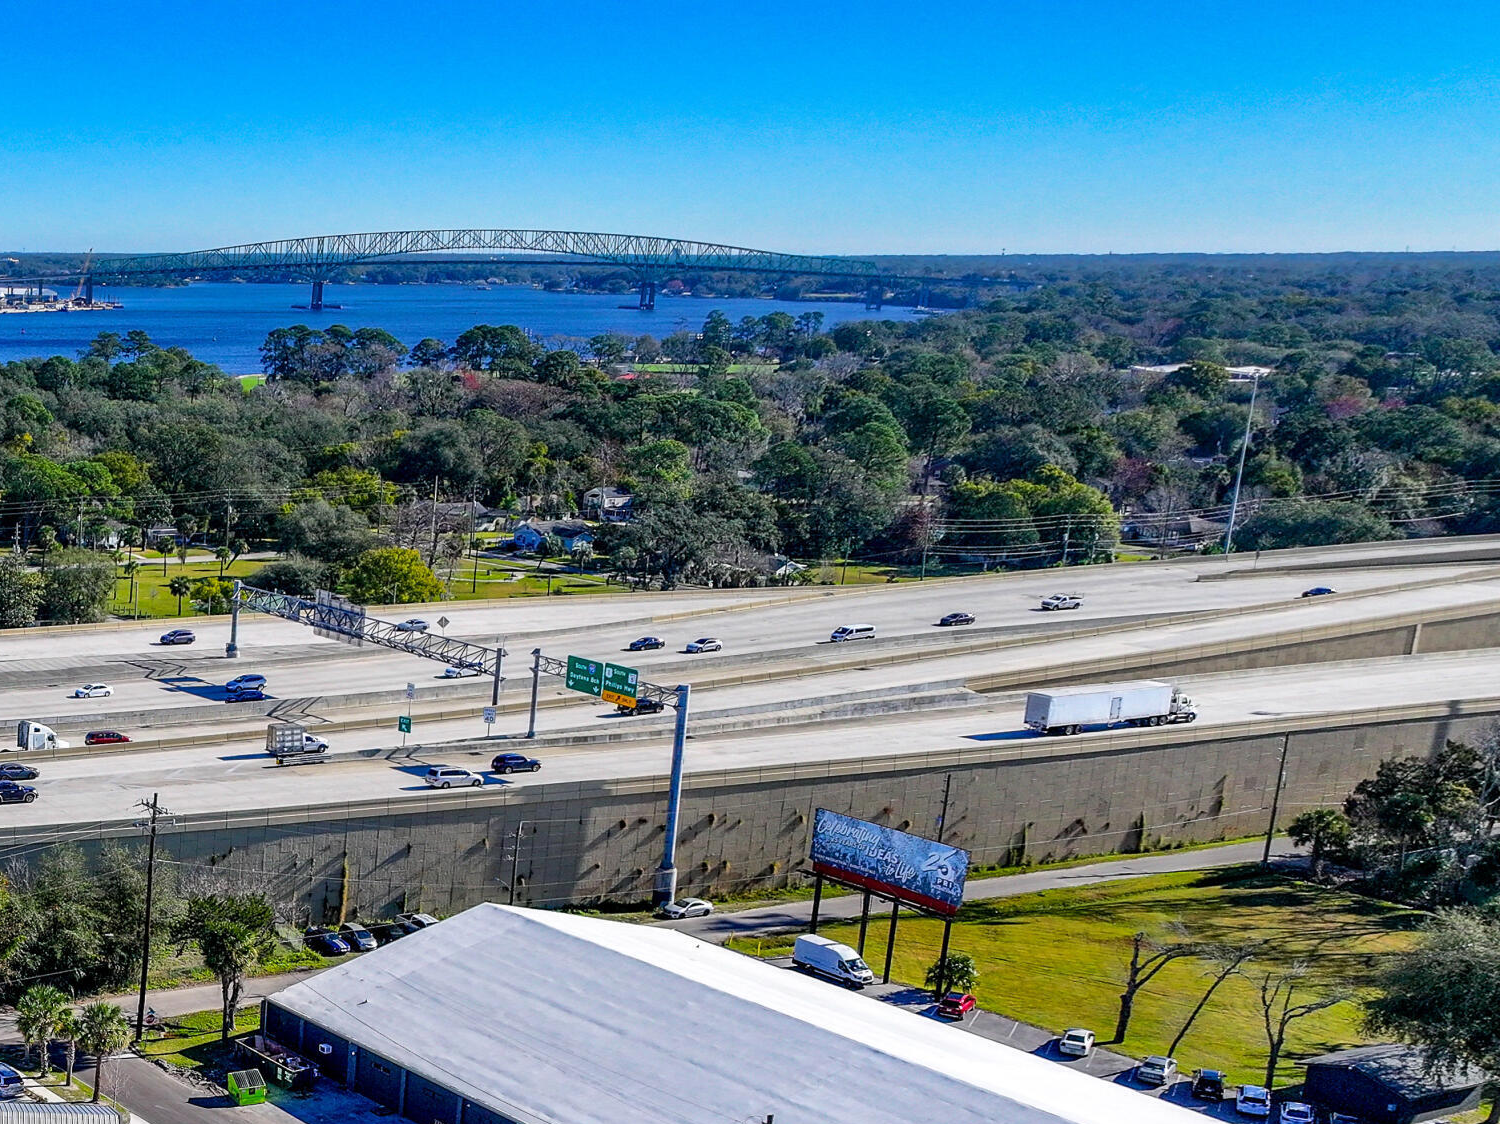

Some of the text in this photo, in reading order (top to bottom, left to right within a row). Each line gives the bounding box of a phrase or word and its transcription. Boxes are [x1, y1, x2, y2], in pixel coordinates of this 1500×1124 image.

[817, 816, 881, 851] Celebrating
[865, 846, 899, 864] IDEAS
[885, 862, 895, 876] to
[895, 861, 916, 884] Life
[936, 878, 953, 889] PRI
